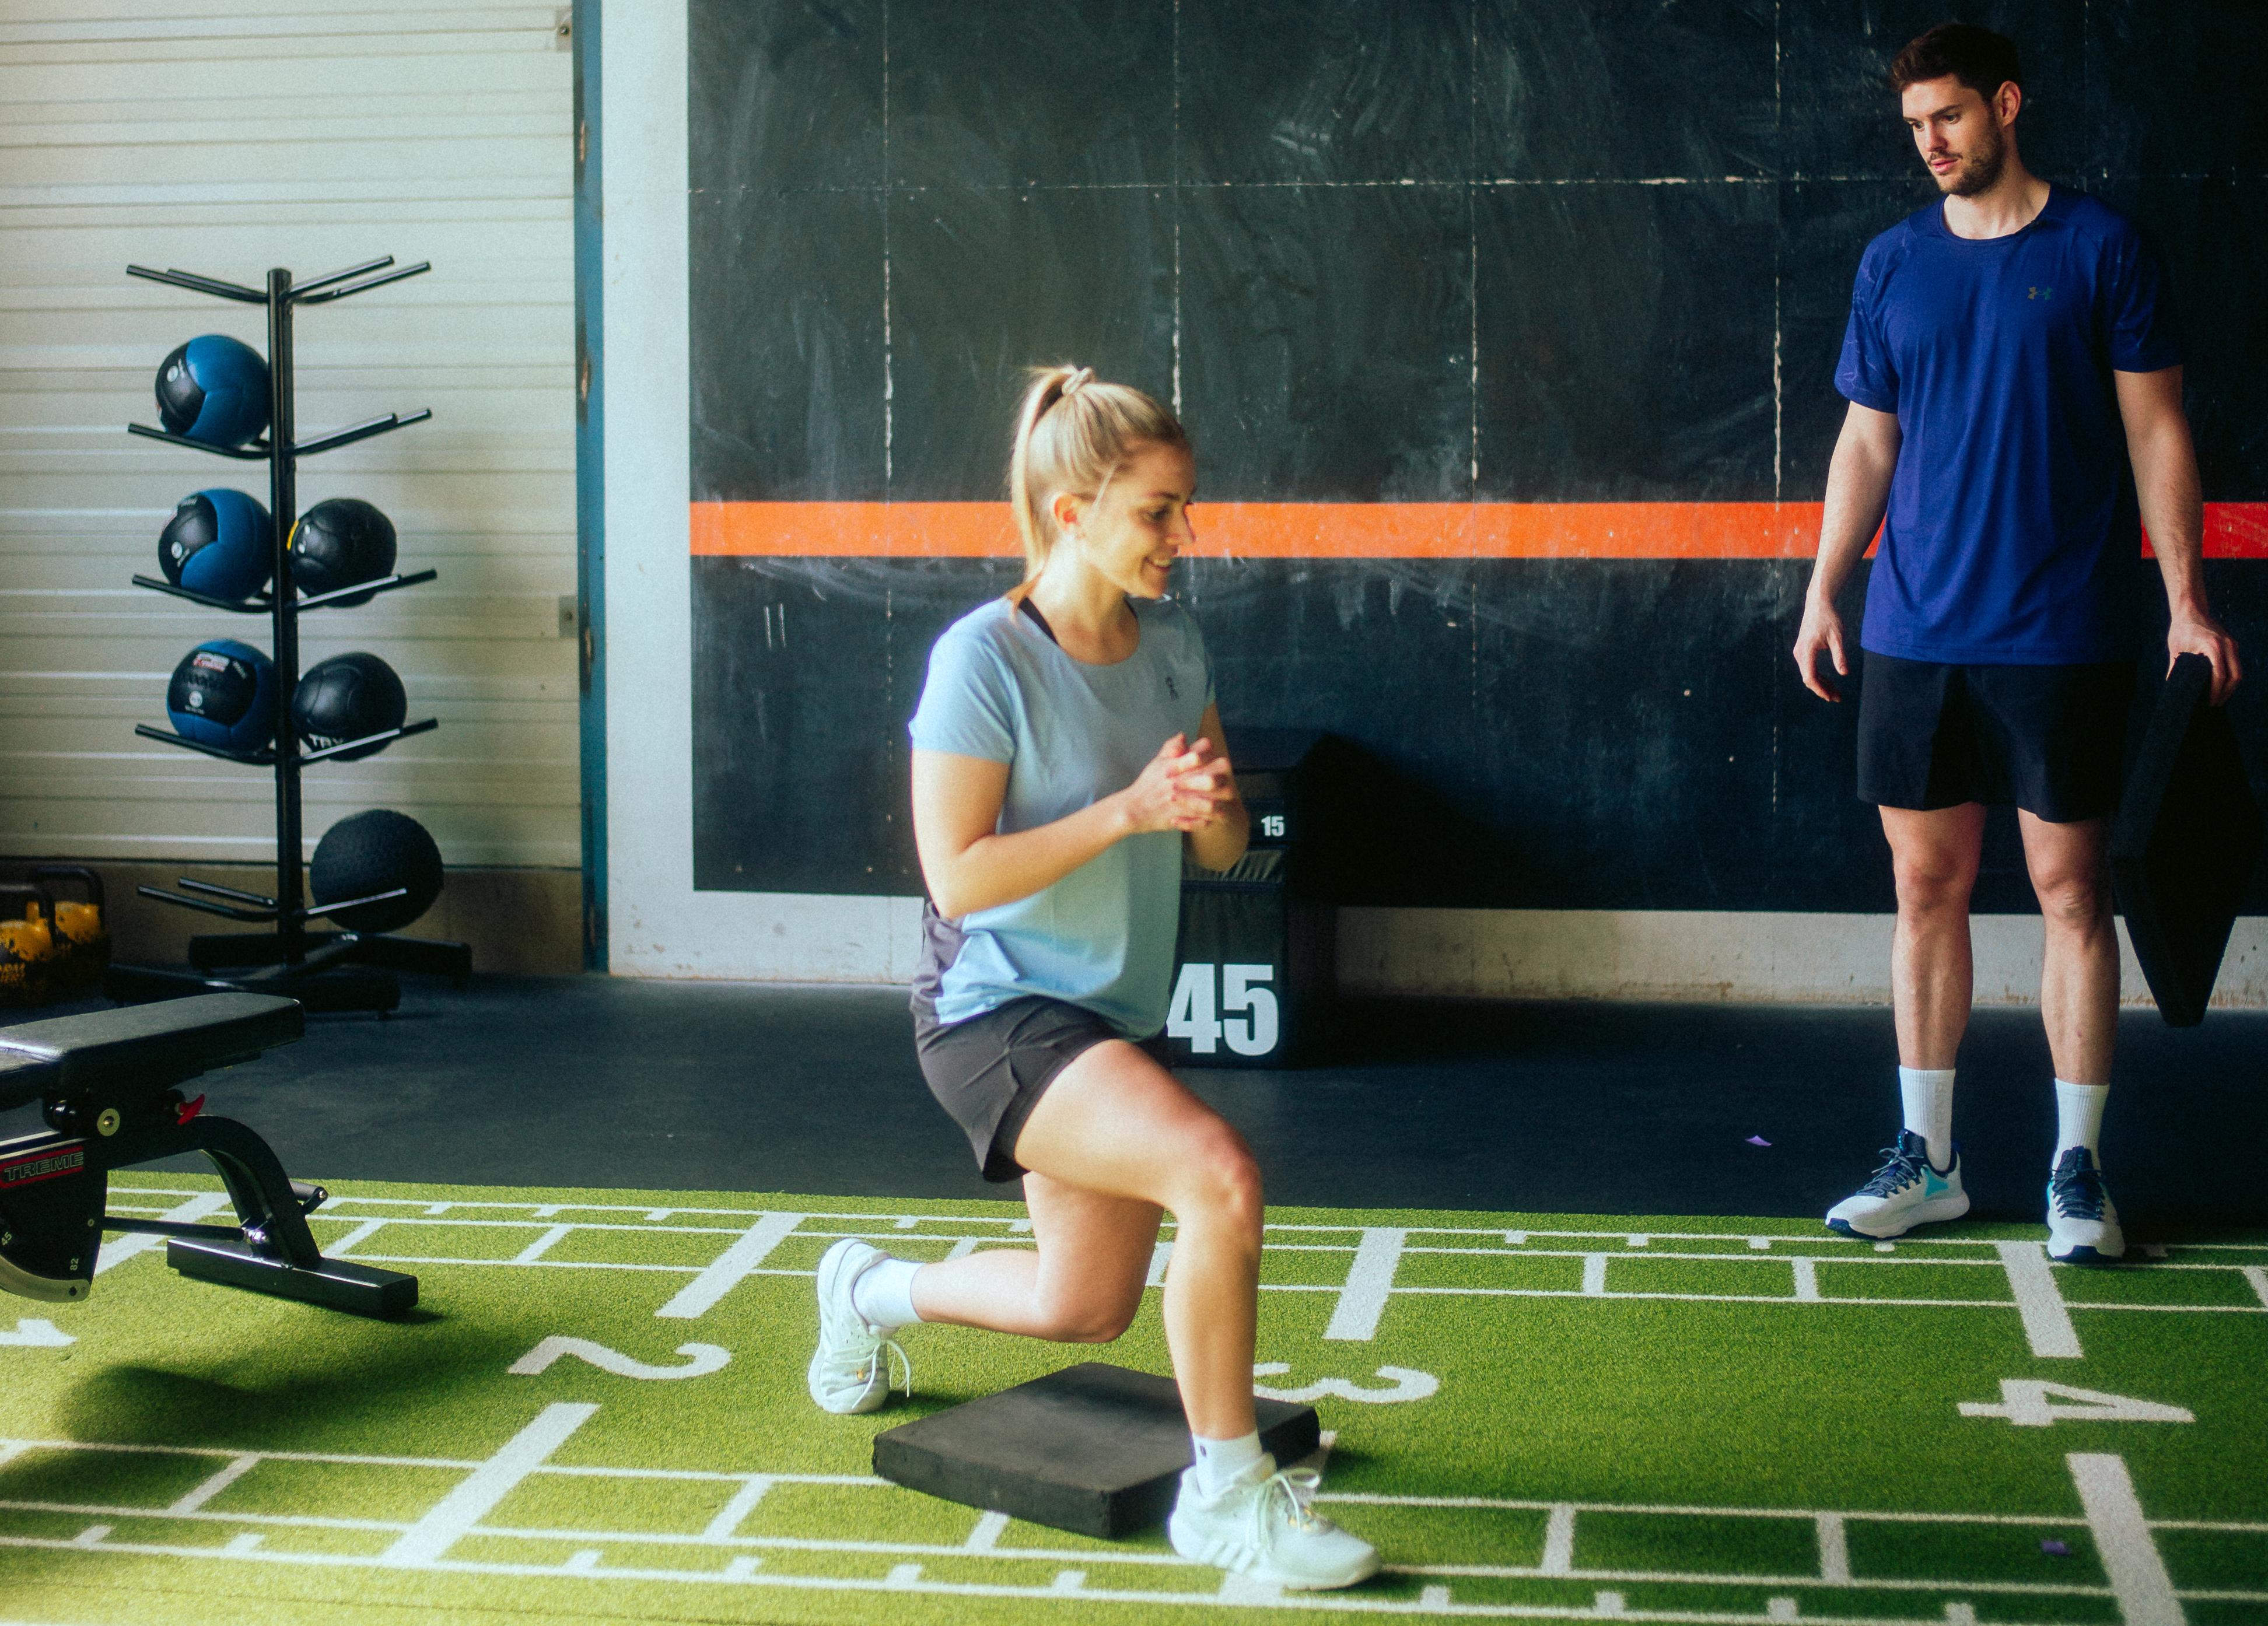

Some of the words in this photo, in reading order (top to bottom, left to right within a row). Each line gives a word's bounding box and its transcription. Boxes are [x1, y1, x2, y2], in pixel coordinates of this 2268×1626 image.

[1261, 816, 1284, 836] 15
[1166, 963, 1279, 1056] 45
[1, 1150, 84, 1184] TREME
[2, 1232, 12, 1246] 45
[70, 1258, 79, 1270] 82
[508, 1335, 732, 1380] 2
[1252, 1362, 1440, 1404] 3
[1957, 1379, 2196, 1426] 4
